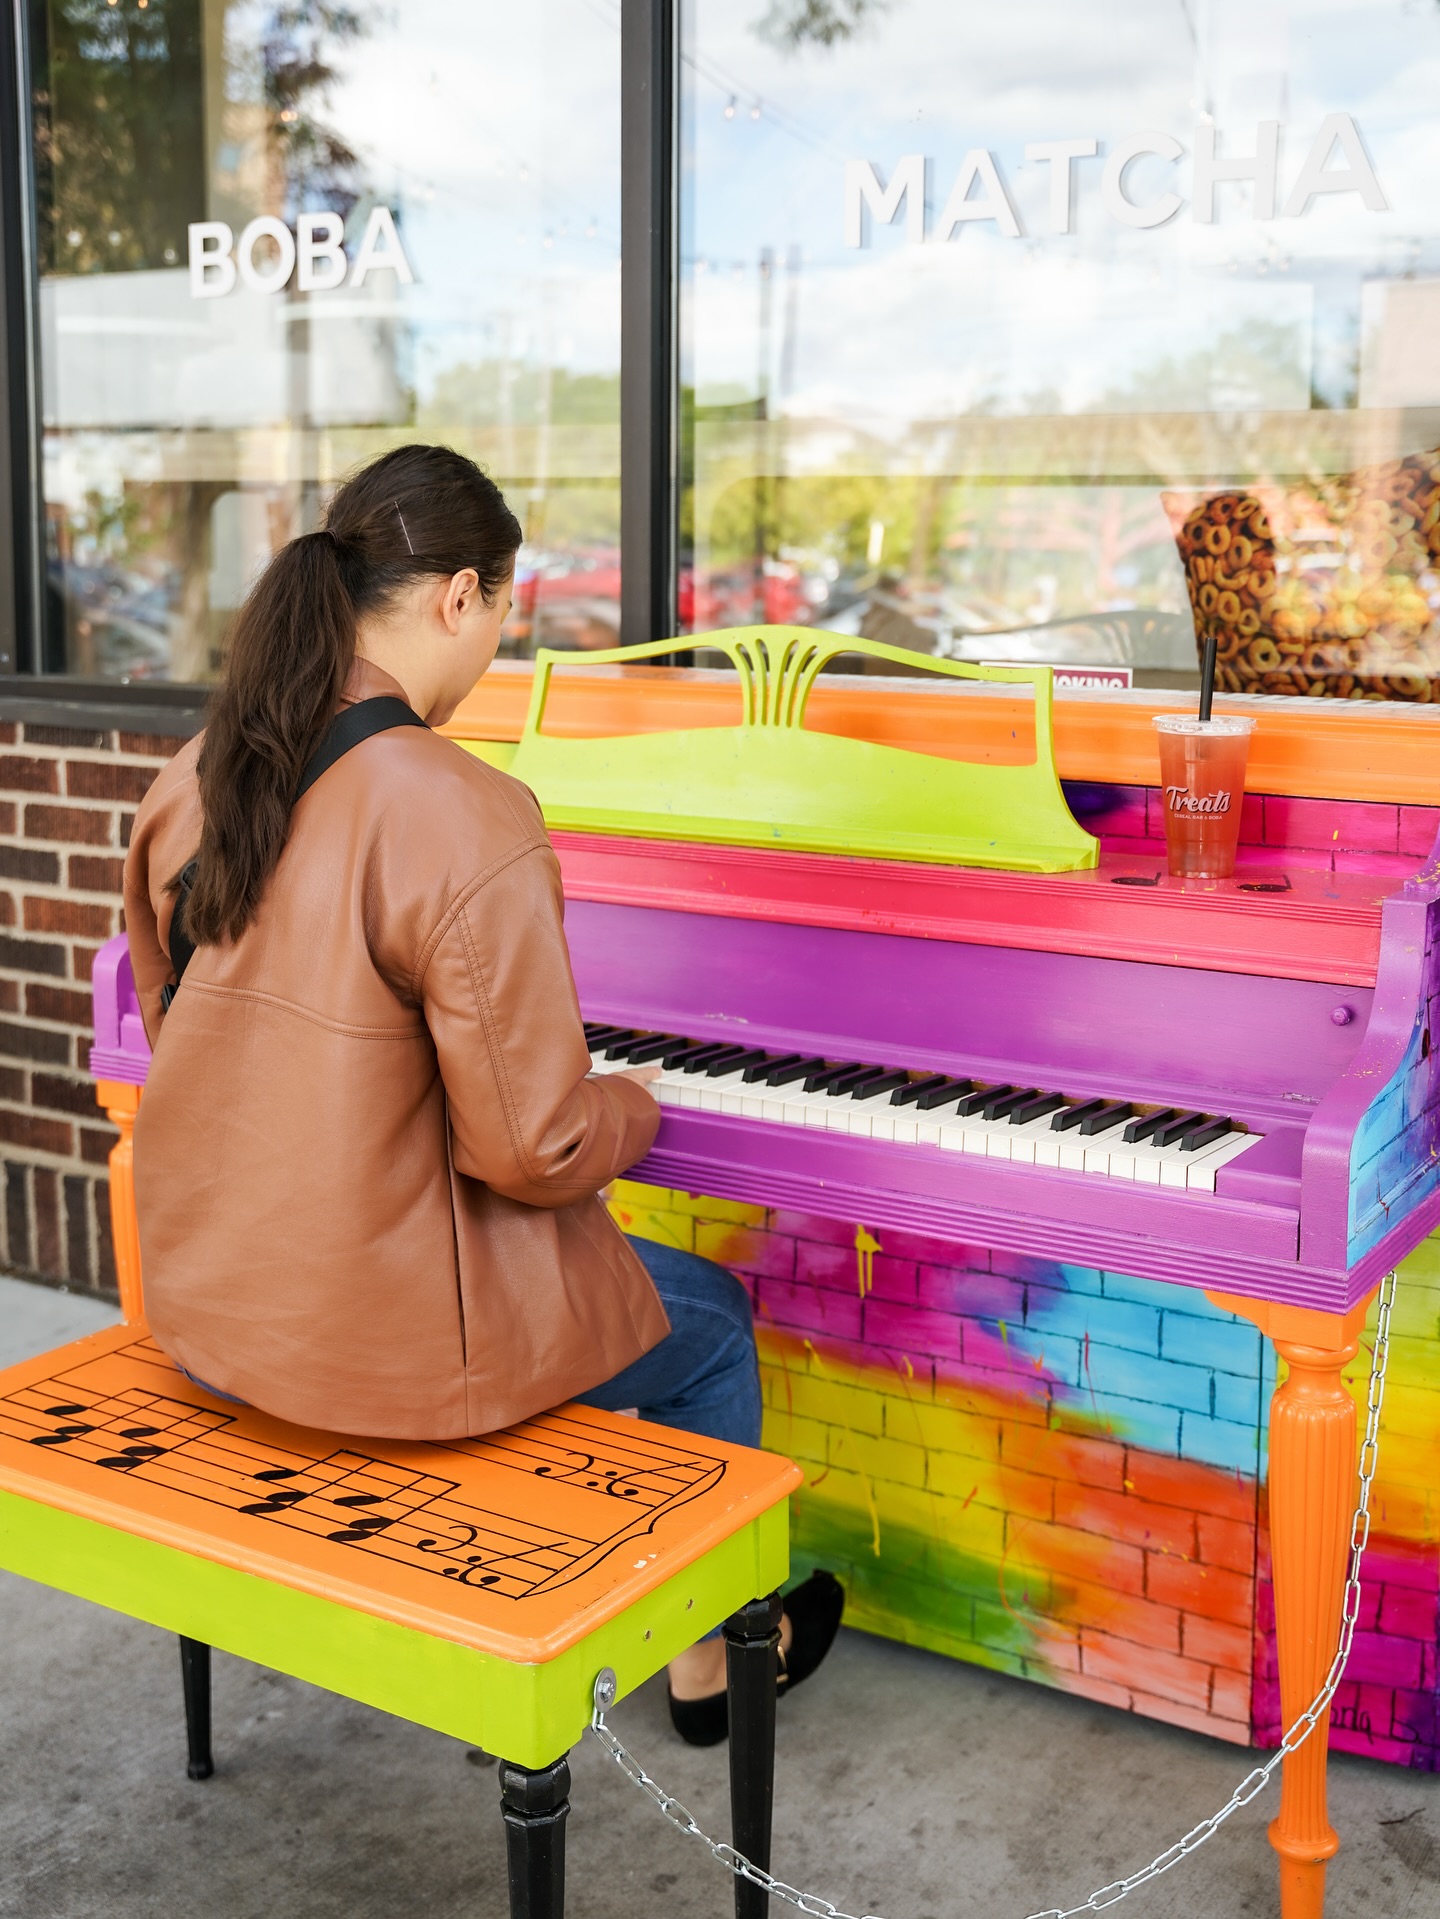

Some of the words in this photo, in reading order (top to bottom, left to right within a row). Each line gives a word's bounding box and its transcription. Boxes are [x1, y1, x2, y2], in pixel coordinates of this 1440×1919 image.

[843, 111, 1390, 249] MATCHA
[188, 206, 414, 298] BOBA
[1166, 785, 1231, 813] Treats
